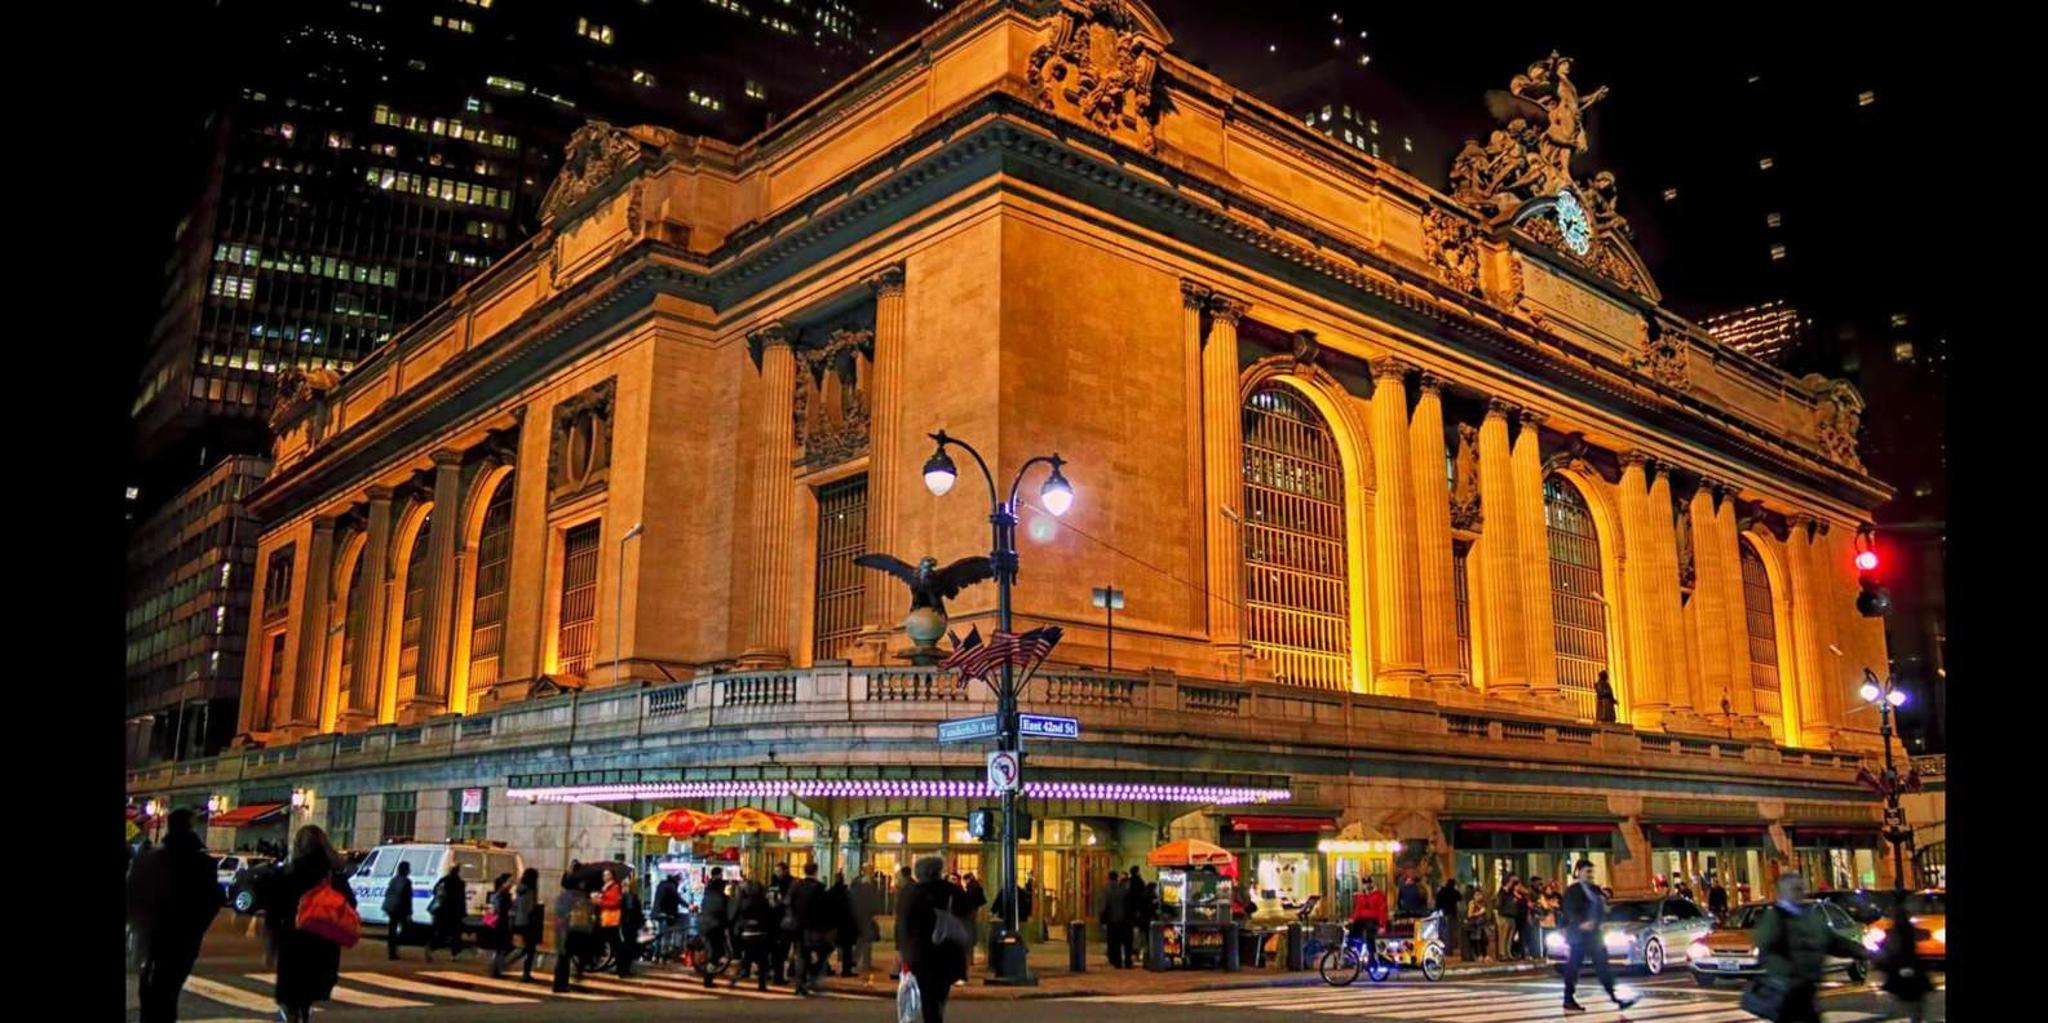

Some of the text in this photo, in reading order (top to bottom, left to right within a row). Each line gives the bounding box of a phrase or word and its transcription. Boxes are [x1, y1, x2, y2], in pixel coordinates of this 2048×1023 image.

[981, 720, 996, 733] Ave
[1023, 719, 1074, 734] East 42nd St
[356, 886, 386, 897] POLICE
